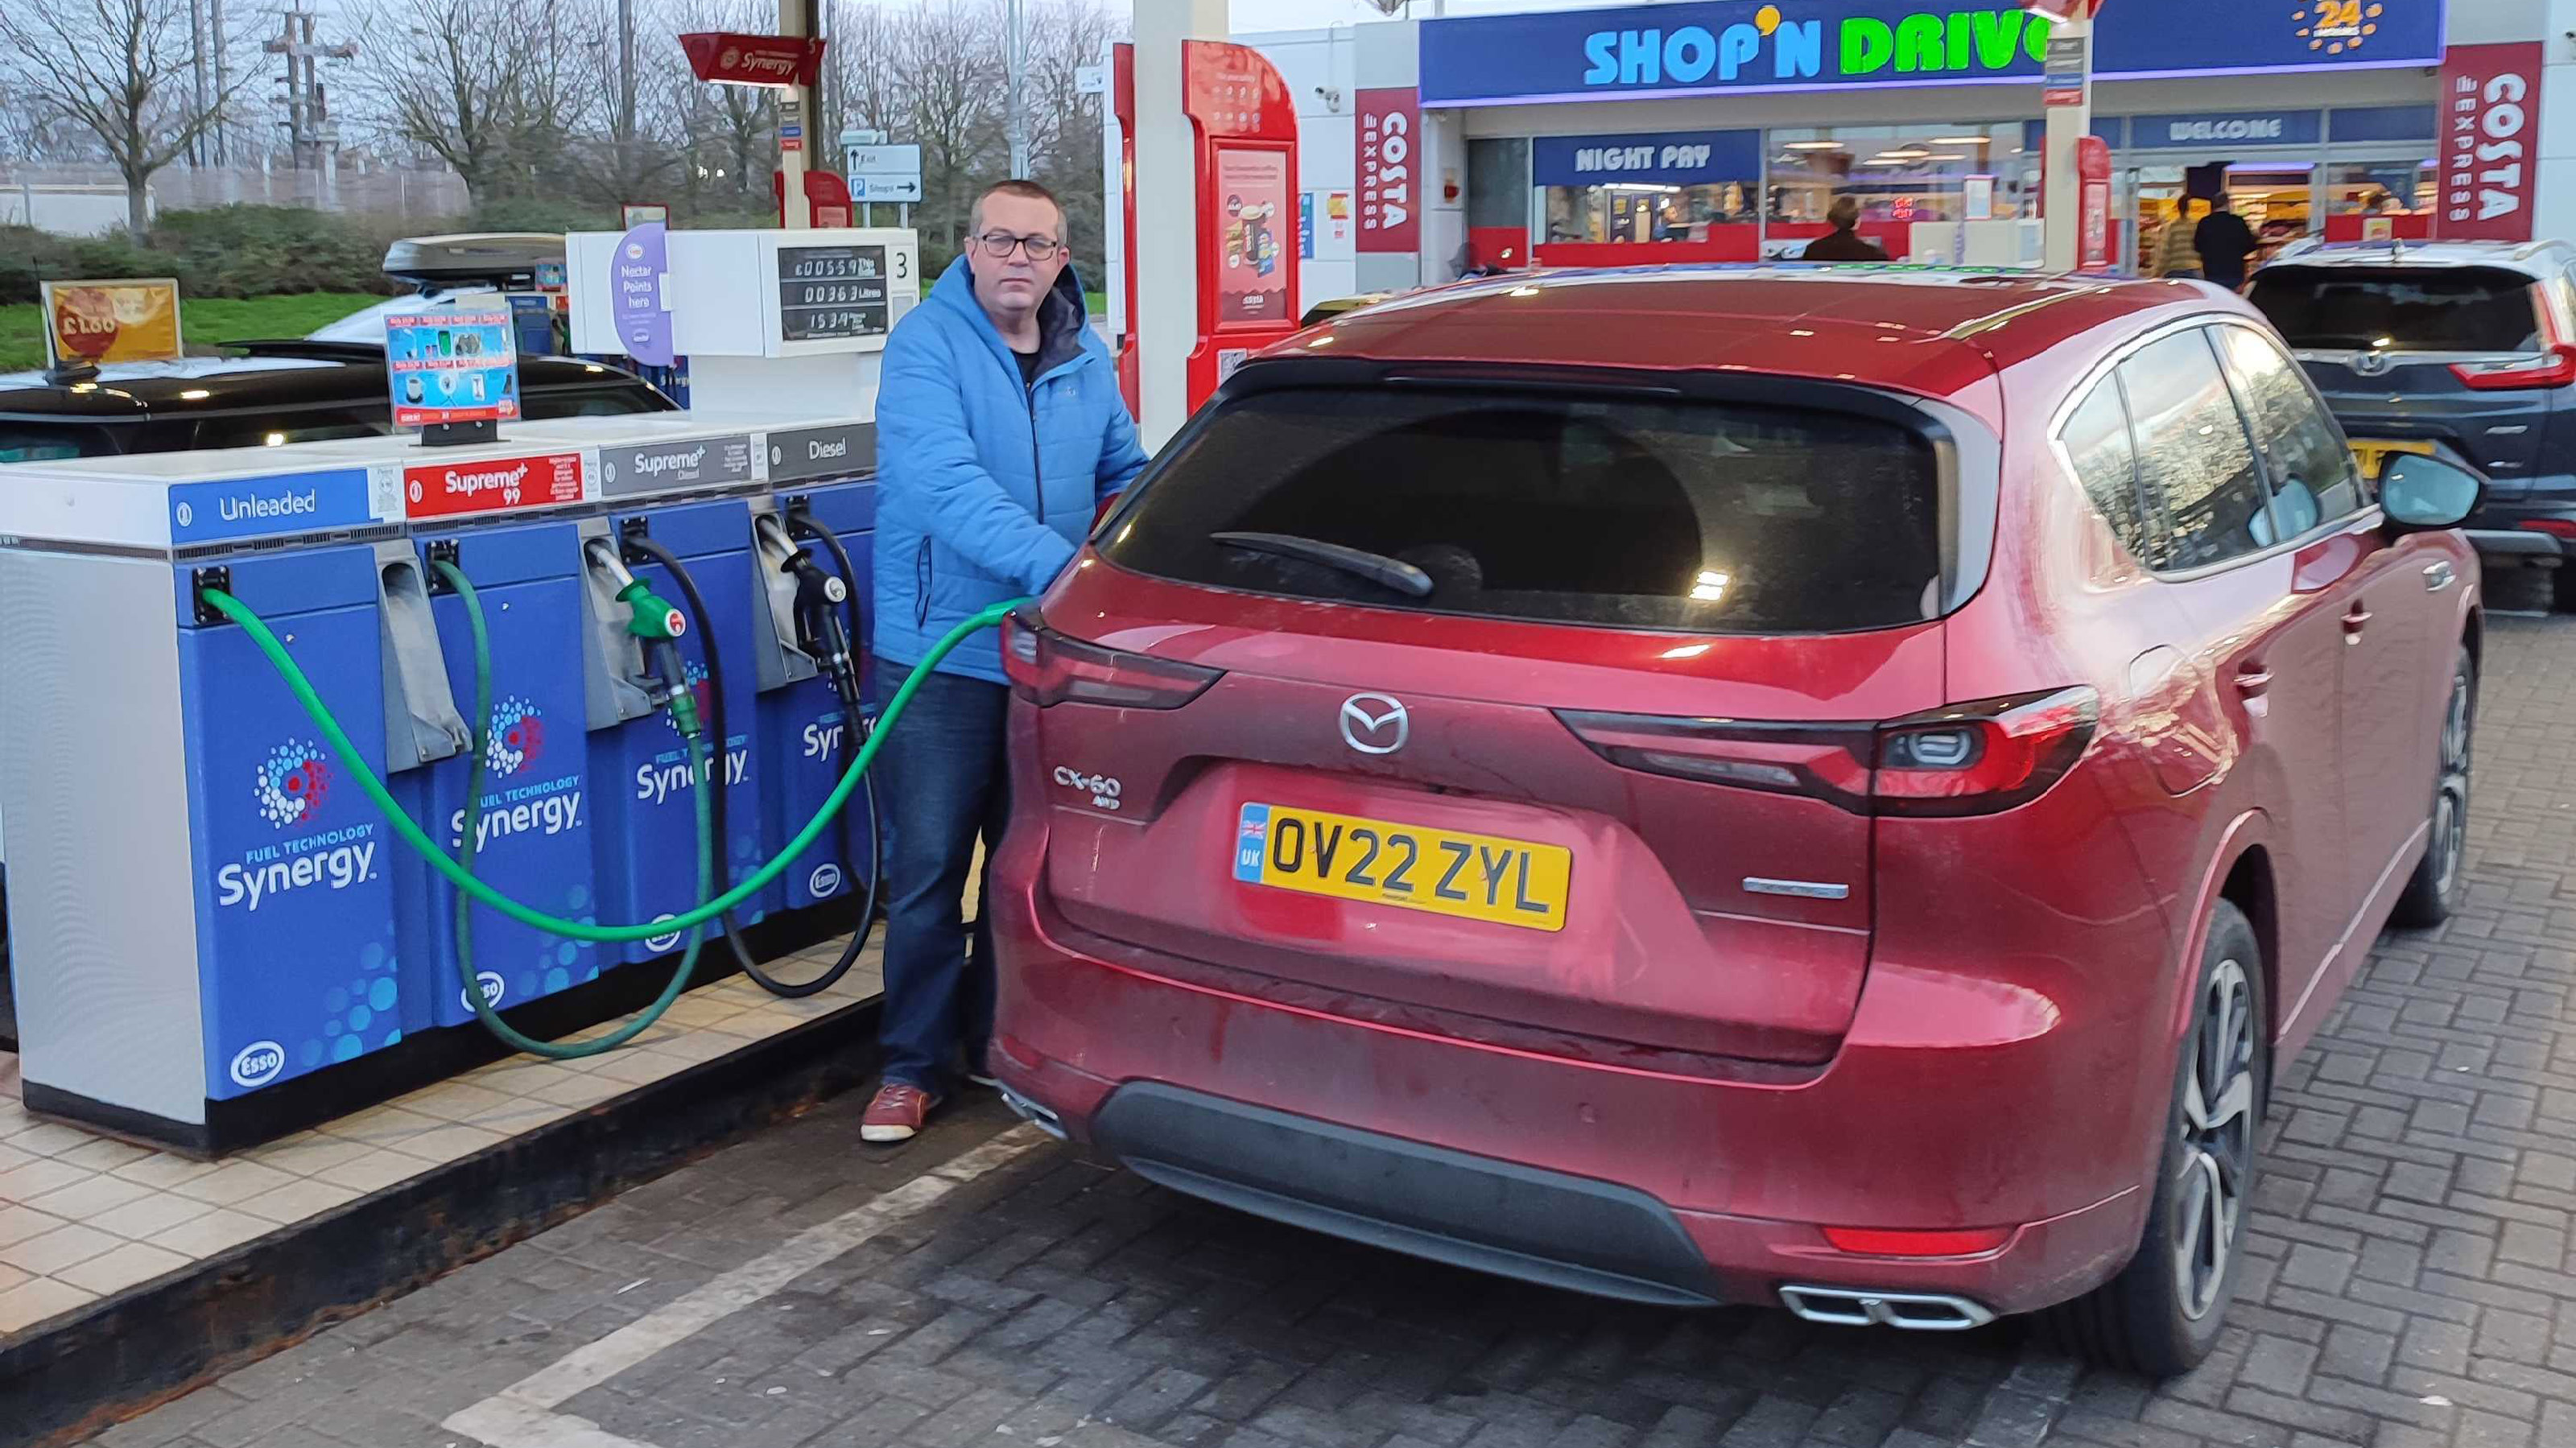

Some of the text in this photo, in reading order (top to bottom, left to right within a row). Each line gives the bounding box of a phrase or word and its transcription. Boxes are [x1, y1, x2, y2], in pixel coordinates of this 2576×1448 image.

[1584, 5, 1821, 85] SHOP'N
[741, 52, 798, 75] Synergy
[2169, 118, 2282, 142] WELCOME
[2475, 72, 2527, 221] COSTA
[1380, 111, 1408, 229] COSTA
[1575, 144, 1711, 172] NIGHT PAY
[2448, 97, 2477, 221] EXPRESS
[1362, 130, 1377, 230] EXPRESS
[621, 265, 653, 278] Nectar
[896, 251, 907, 279] 3
[623, 280, 653, 294] Points
[628, 295, 650, 309] here
[808, 437, 846, 460] Diesel
[218, 489, 316, 522] Unleaded
[502, 488, 522, 505] 99
[480, 775, 580, 809] UEL TECHNOLOGY
[1053, 765, 1121, 798] CX-60
[246, 823, 374, 865] FUEL TECHNOLOGY
[218, 841, 376, 912] Synergy
[1241, 817, 1550, 914] UK OV22 ZYL
